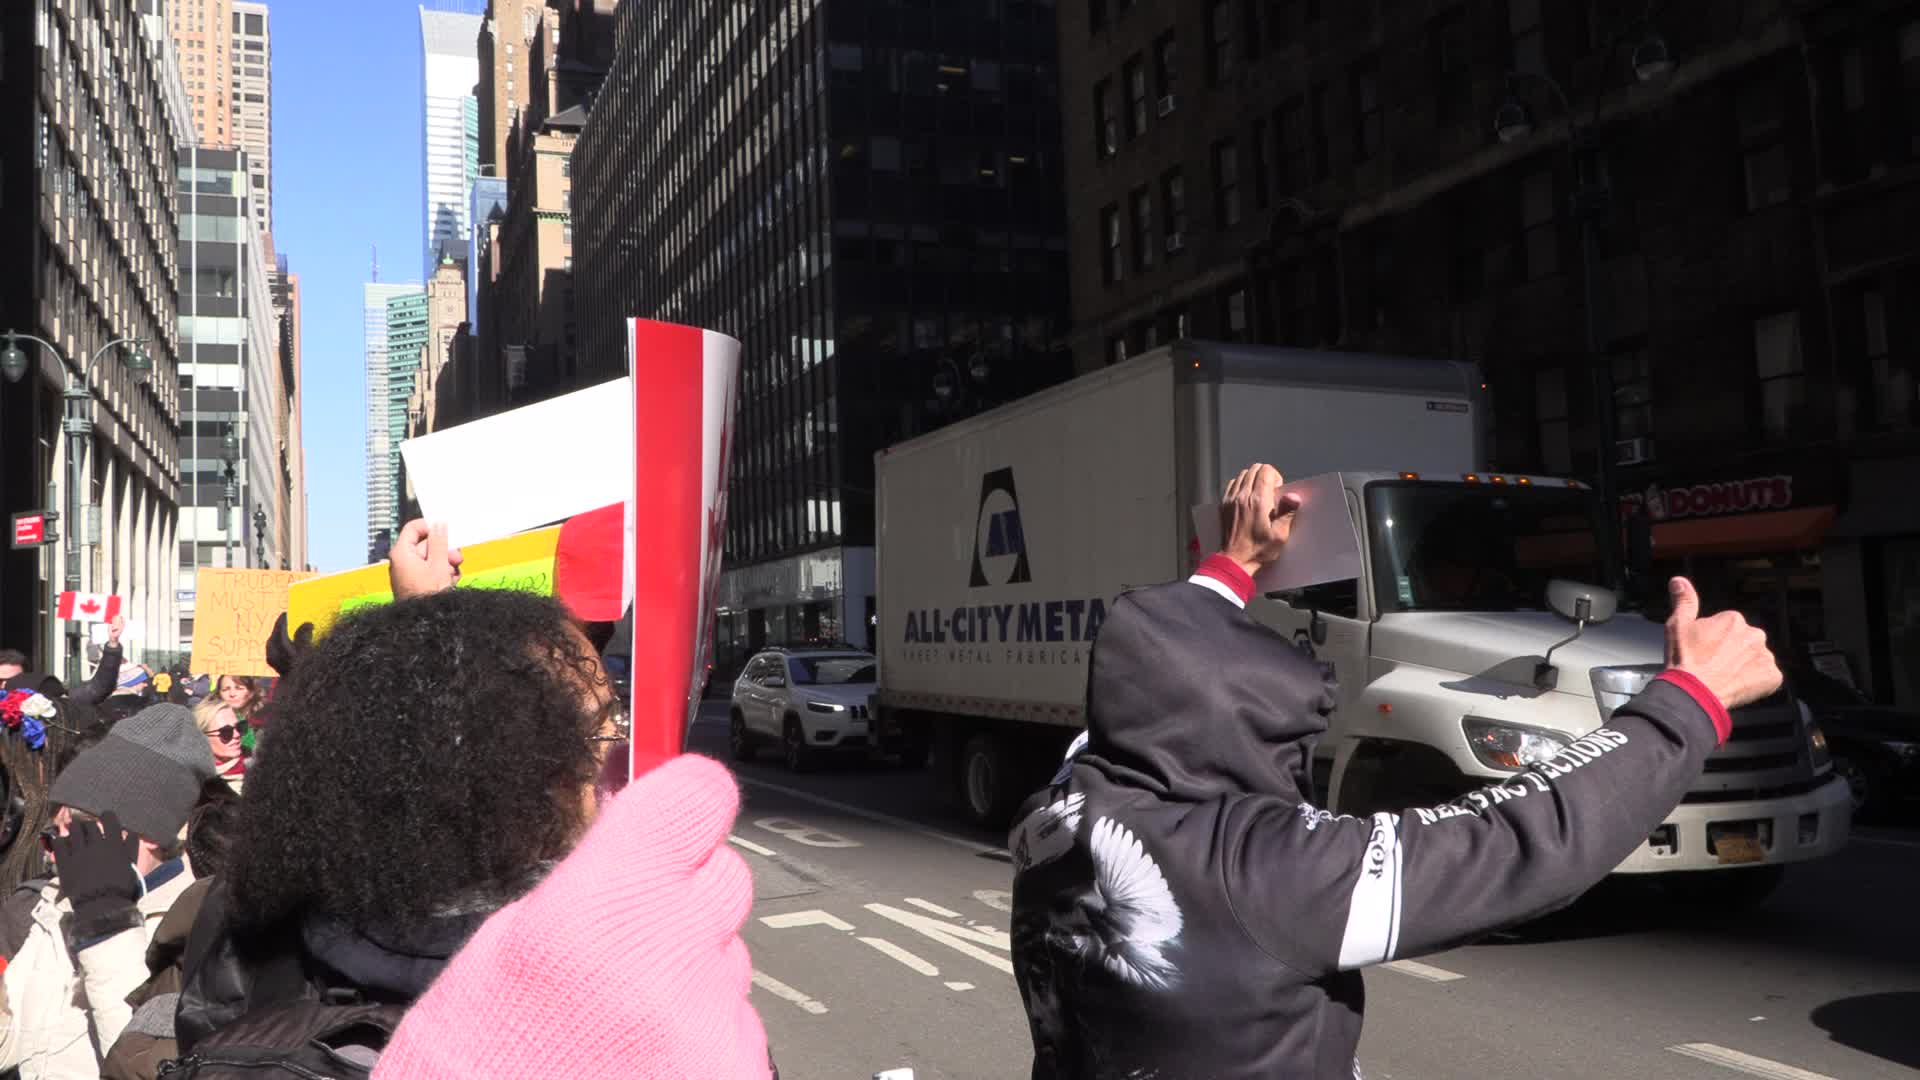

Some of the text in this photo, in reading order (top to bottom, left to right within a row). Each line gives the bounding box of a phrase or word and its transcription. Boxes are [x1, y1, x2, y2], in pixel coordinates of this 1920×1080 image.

[1667, 476, 1793, 518] DONUTS
[210, 591, 268, 612] MUST
[235, 611, 279, 635] NY
[199, 657, 241, 677] THE
